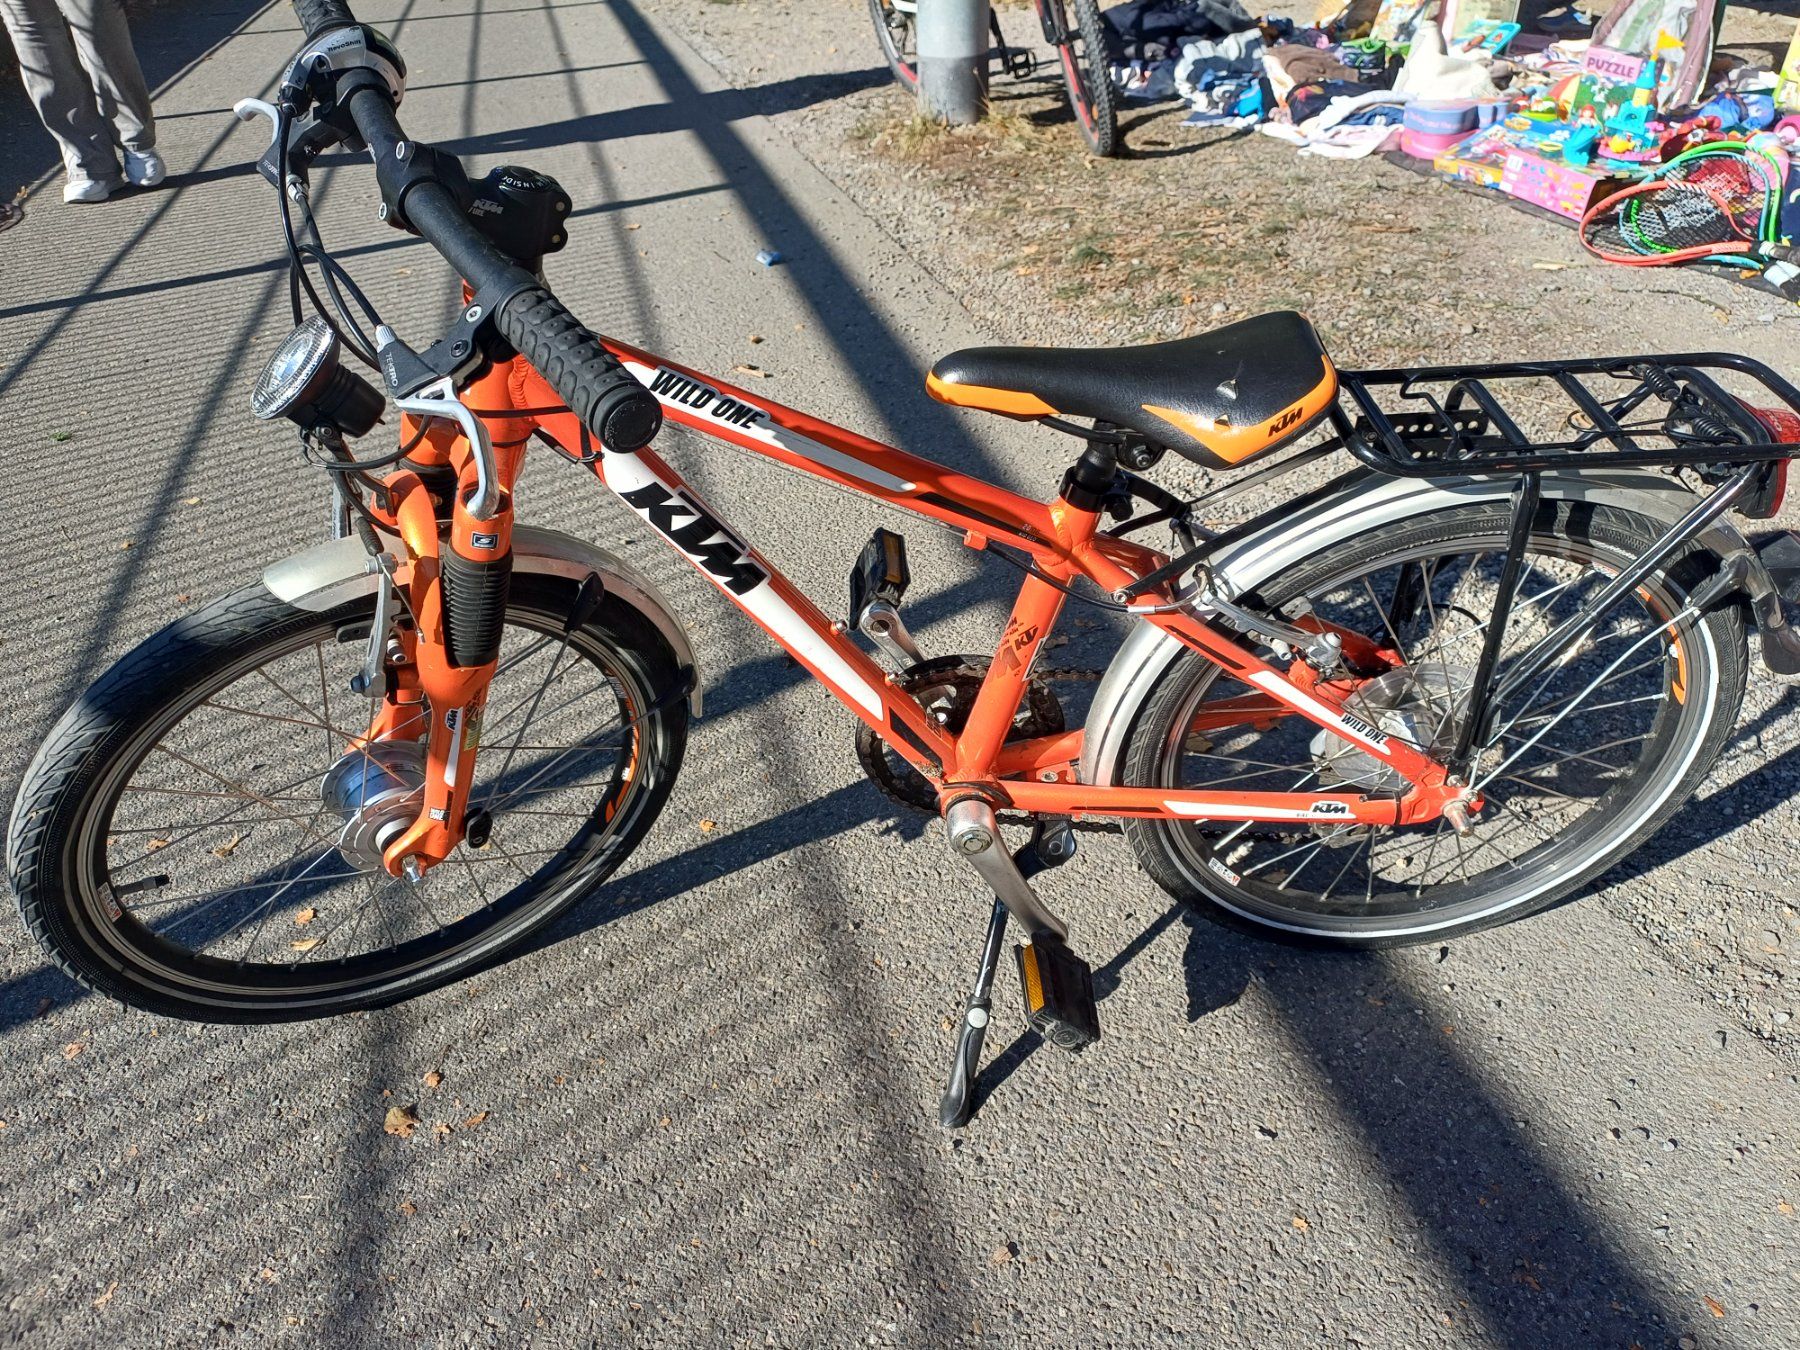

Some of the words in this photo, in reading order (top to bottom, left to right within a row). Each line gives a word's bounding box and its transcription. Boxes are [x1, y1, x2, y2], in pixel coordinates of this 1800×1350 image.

[1586, 56, 1635, 78] PUZZLE
[472, 198, 504, 215] KTM
[649, 369, 717, 410] WILD
[711, 398, 766, 430] ONE
[1267, 406, 1304, 438] KTM
[618, 481, 769, 597] KTM
[446, 709, 459, 731] KTM
[1341, 713, 1368, 733] WILD
[1364, 728, 1388, 745] ONE
[1312, 802, 1347, 814] KTM
